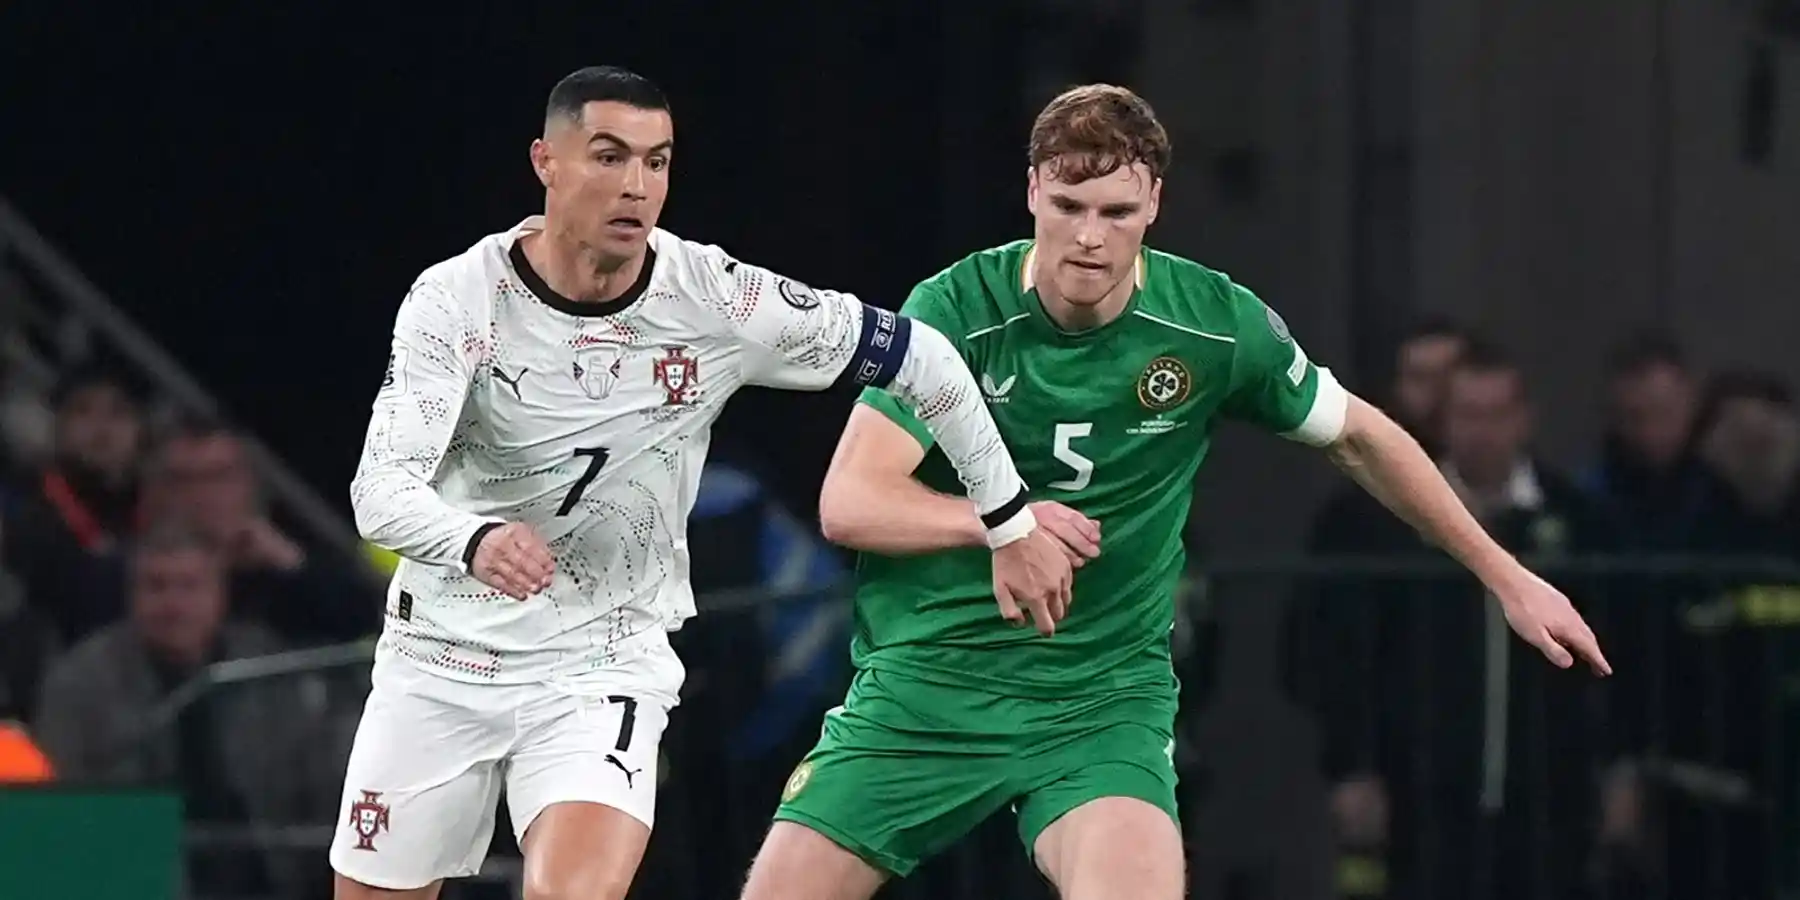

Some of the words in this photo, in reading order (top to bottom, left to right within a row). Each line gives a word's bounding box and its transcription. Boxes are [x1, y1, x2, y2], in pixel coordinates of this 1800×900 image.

[555, 448, 609, 516] 7
[1047, 423, 1094, 491] 5
[608, 695, 637, 752] 7
